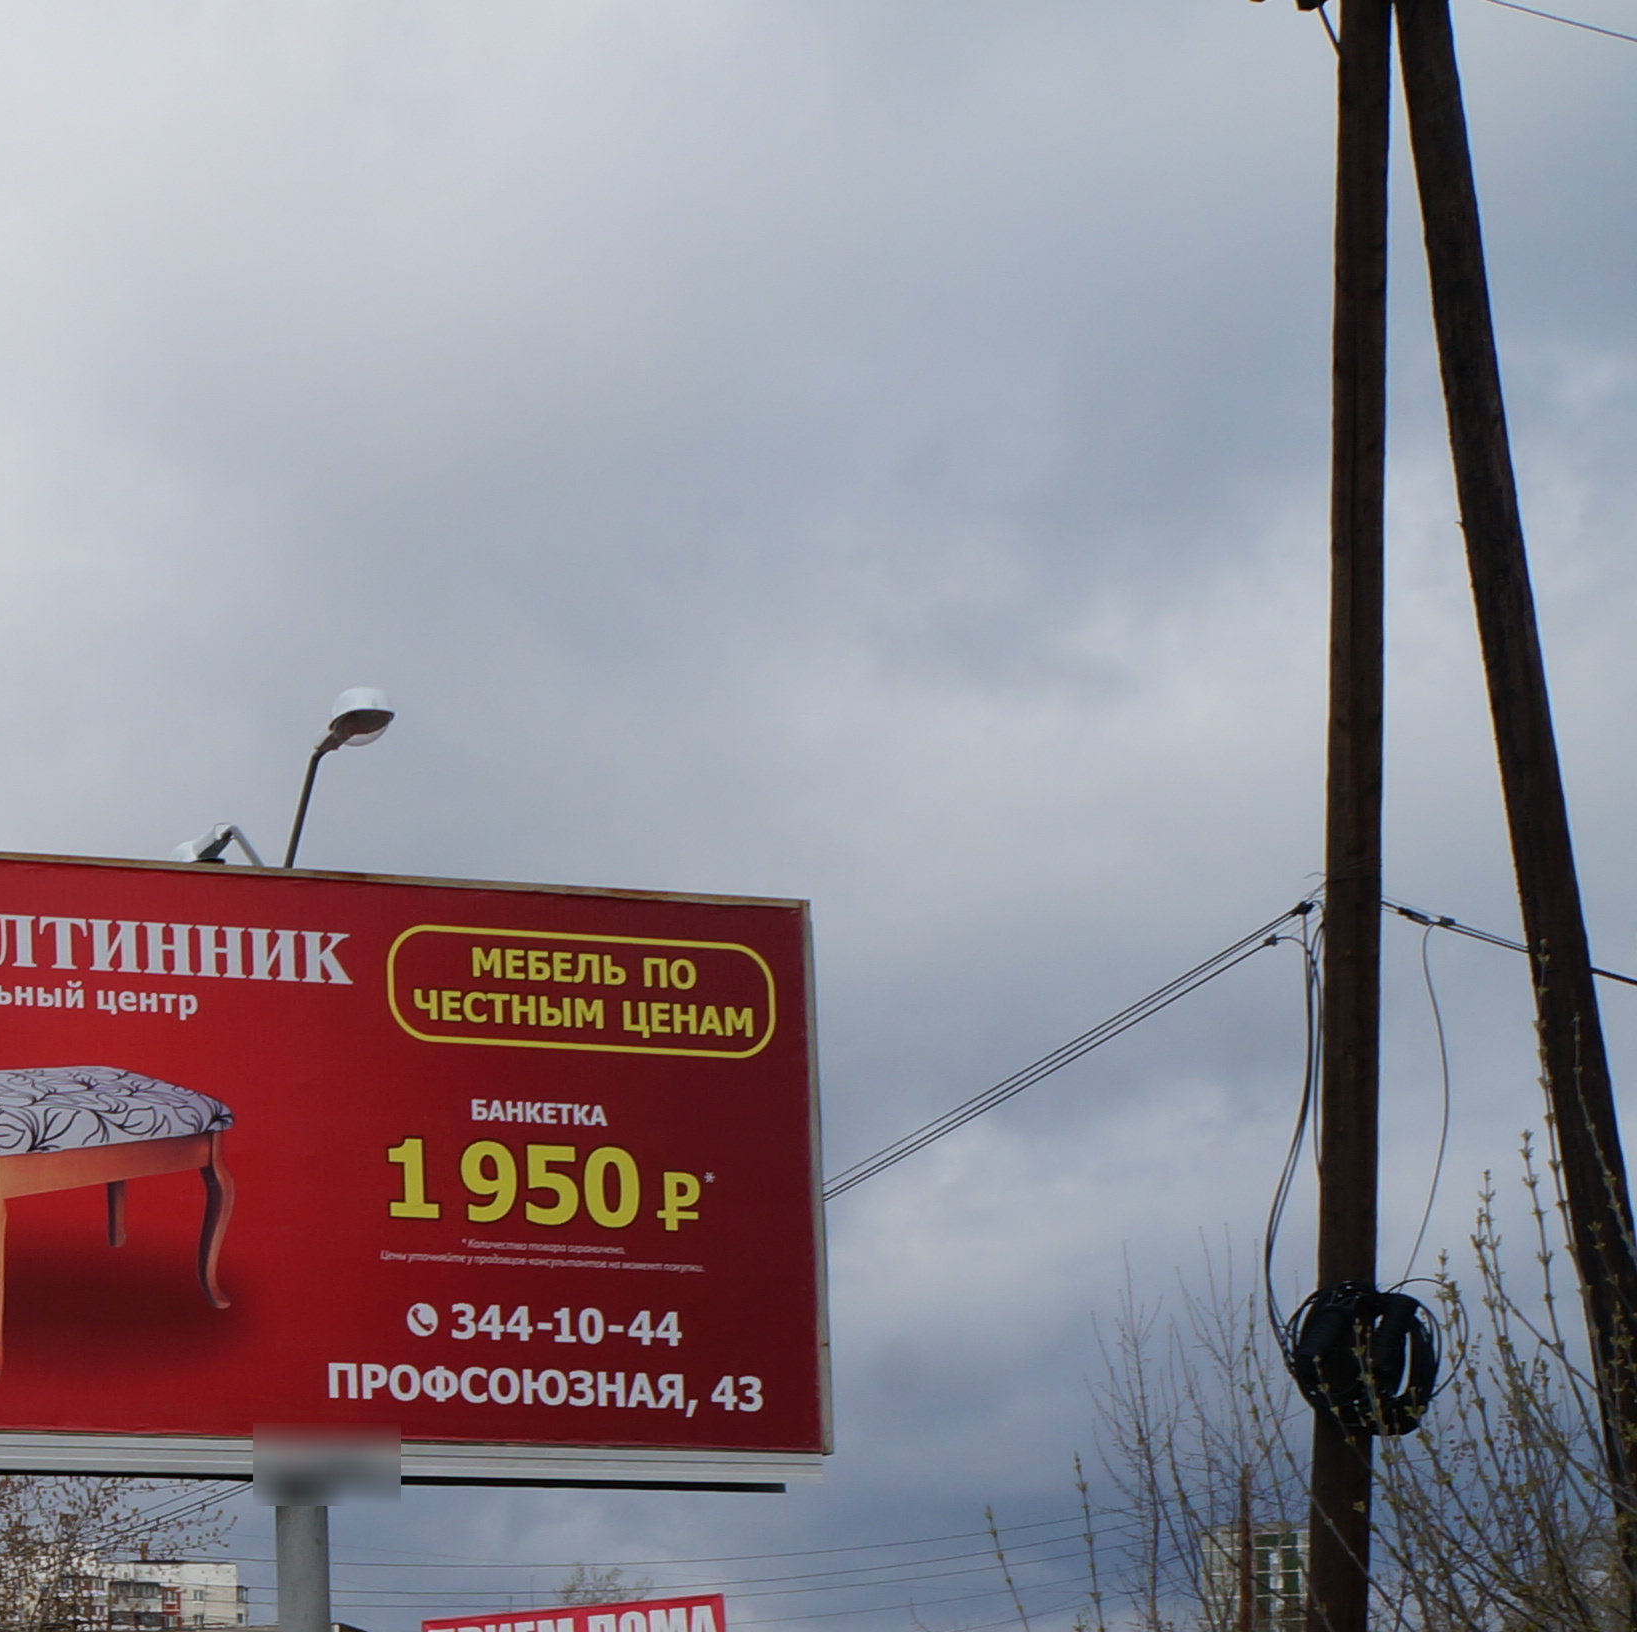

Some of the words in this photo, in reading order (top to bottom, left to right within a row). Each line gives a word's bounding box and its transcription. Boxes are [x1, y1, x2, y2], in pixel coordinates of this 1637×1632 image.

[471, 946, 627, 986] МЕБЕЛЬ
[642, 957, 697, 991] ПО
[96, 989, 199, 1021] центр
[412, 988, 605, 1030] ЧЕСТНЫМ
[622, 1000, 754, 1038] ЦЕНАМ
[470, 1098, 608, 1127] БАНКЕТКА
[451, 1302, 683, 1347] 344-10-44
[327, 1361, 699, 1418] ПРОФСОЮЗНАЯ,
[710, 1375, 764, 1412] 43
